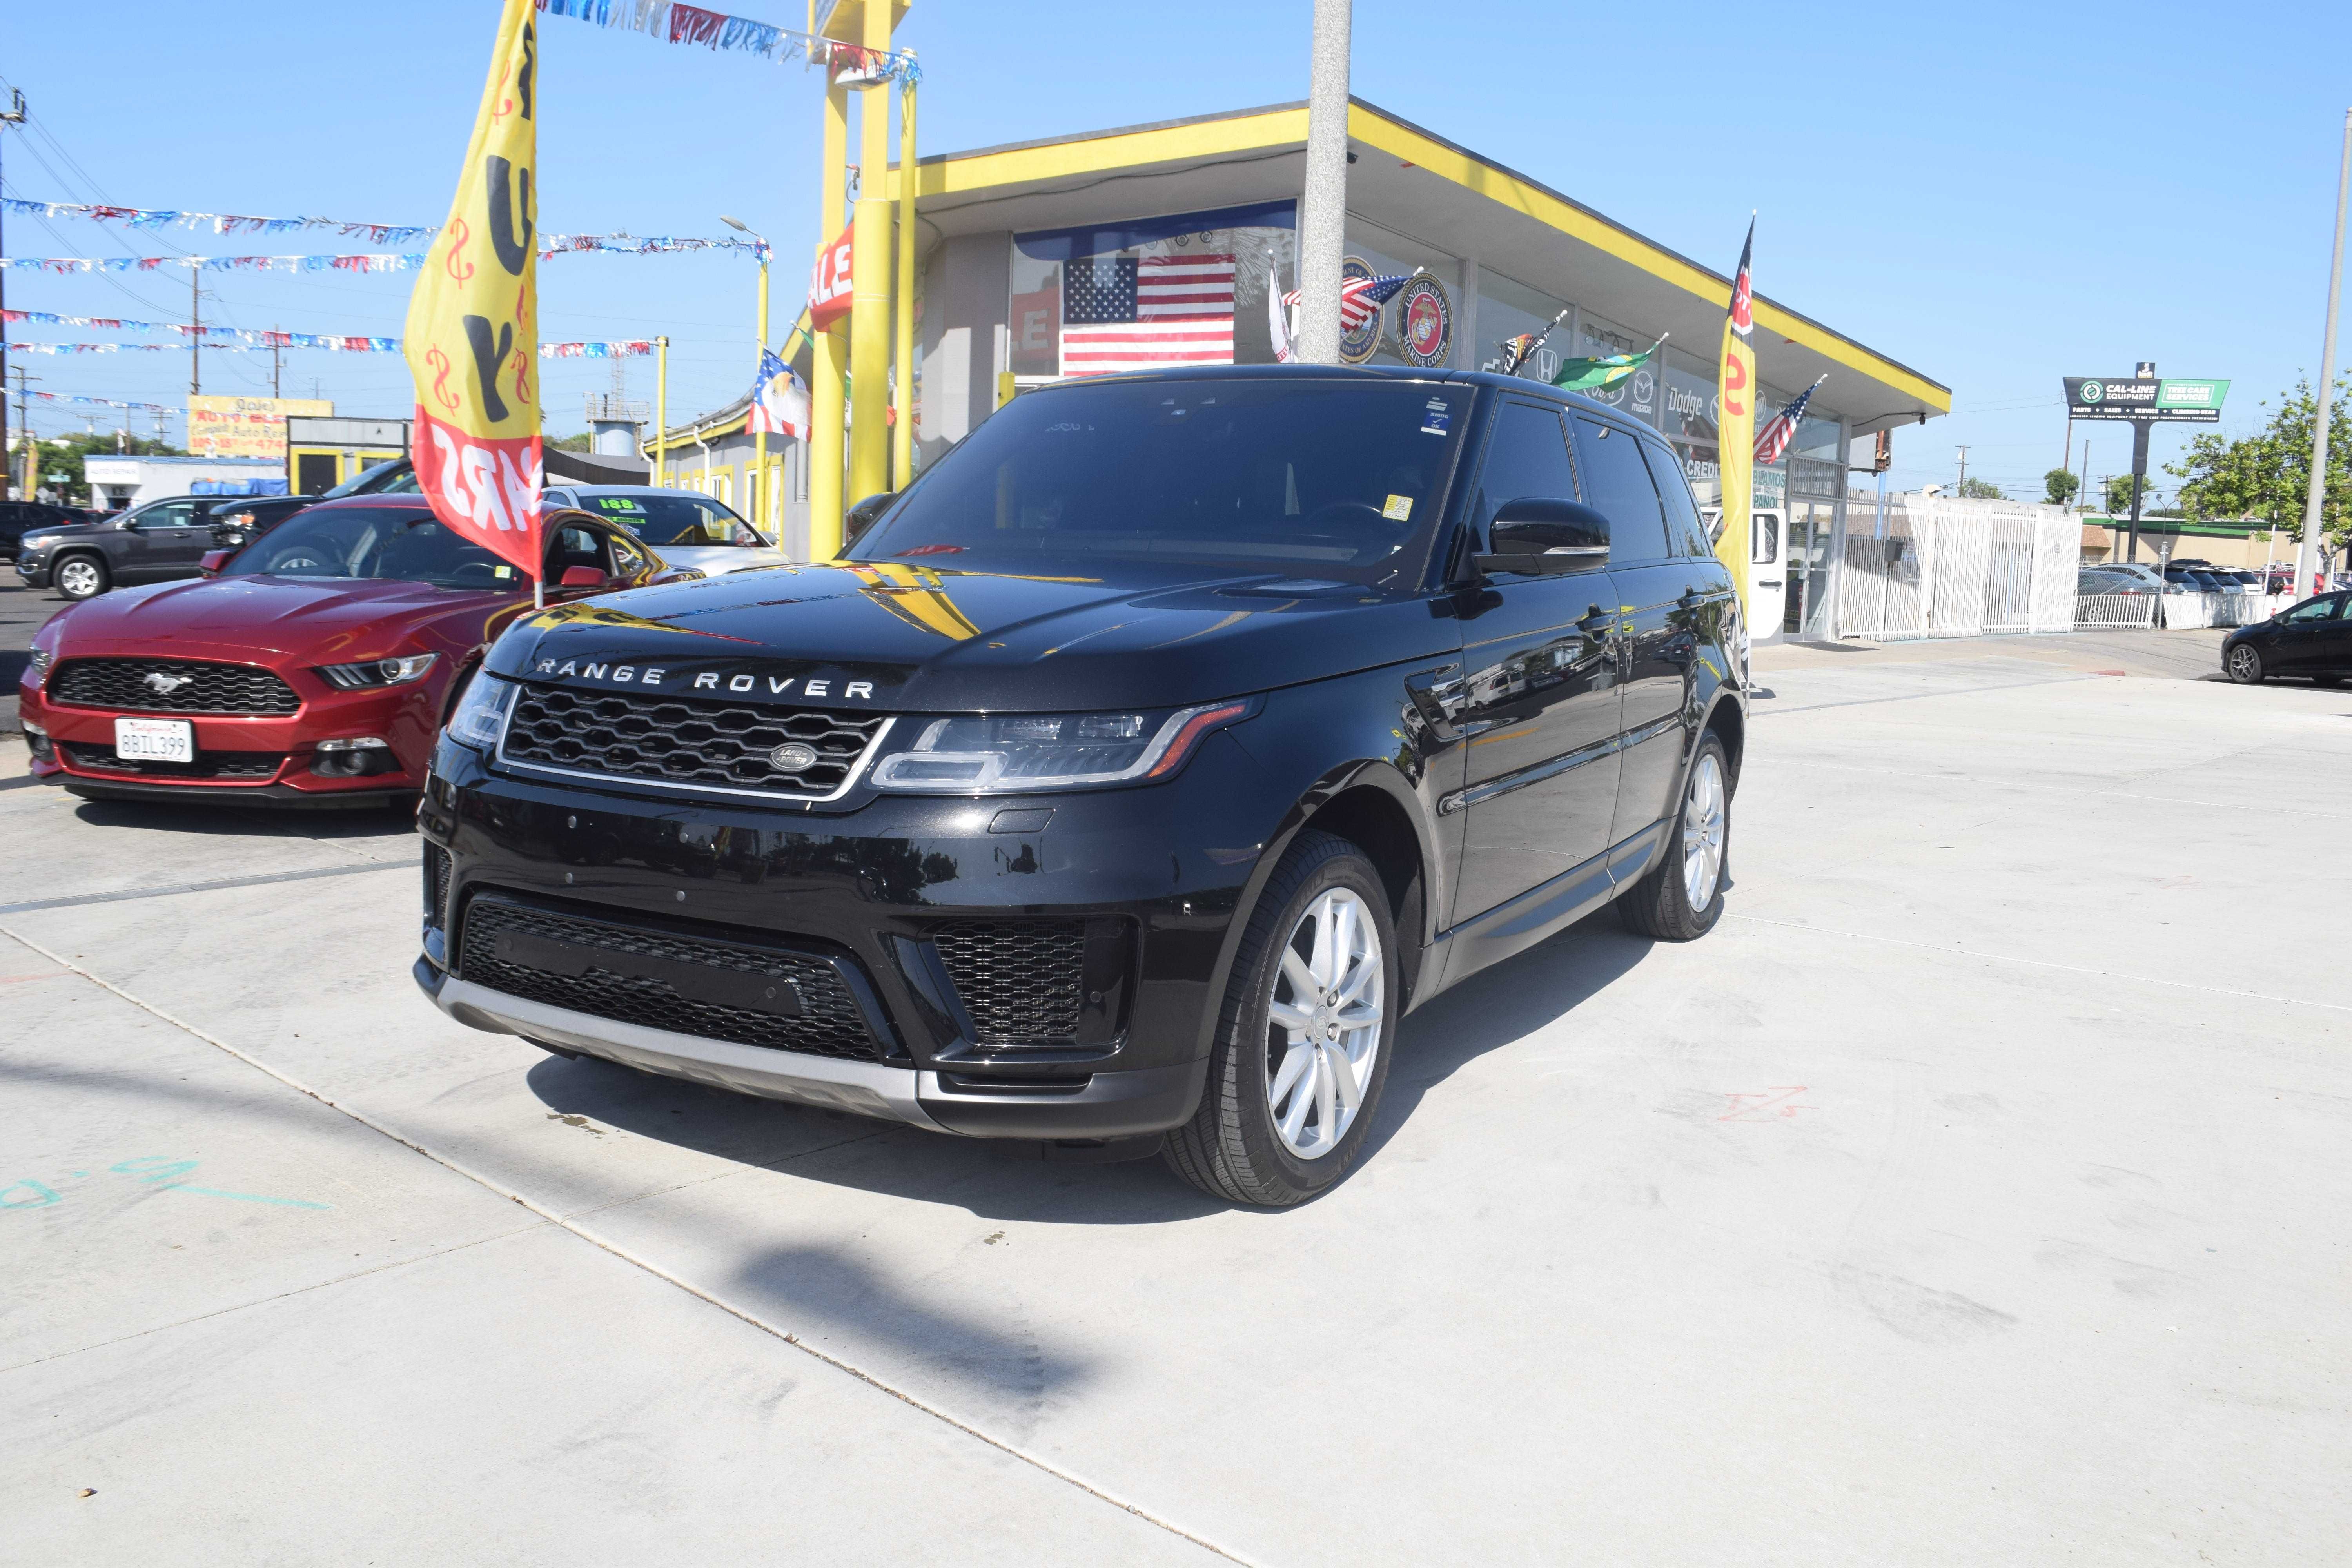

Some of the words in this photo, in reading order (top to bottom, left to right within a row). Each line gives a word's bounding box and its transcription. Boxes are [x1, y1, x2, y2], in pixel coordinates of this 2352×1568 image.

[808, 243, 853, 309] ALE
[1405, 283, 1429, 307] UNITED
[1431, 286, 1448, 324] STATES
[1363, 321, 1378, 349] AMERICA
[1403, 335, 1426, 367] MARINE
[1427, 340, 1447, 367] CORPS
[2106, 385, 2156, 394] CAL-LINE
[1668, 387, 1702, 421] Dodge
[1753, 470, 1786, 488] BLAMOS
[599, 499, 634, 509] 188
[537, 658, 665, 685] RANGE
[693, 672, 873, 699] ROVER
[122, 735, 185, 756] 8BIL399
[780, 756, 807, 764] ROVER
